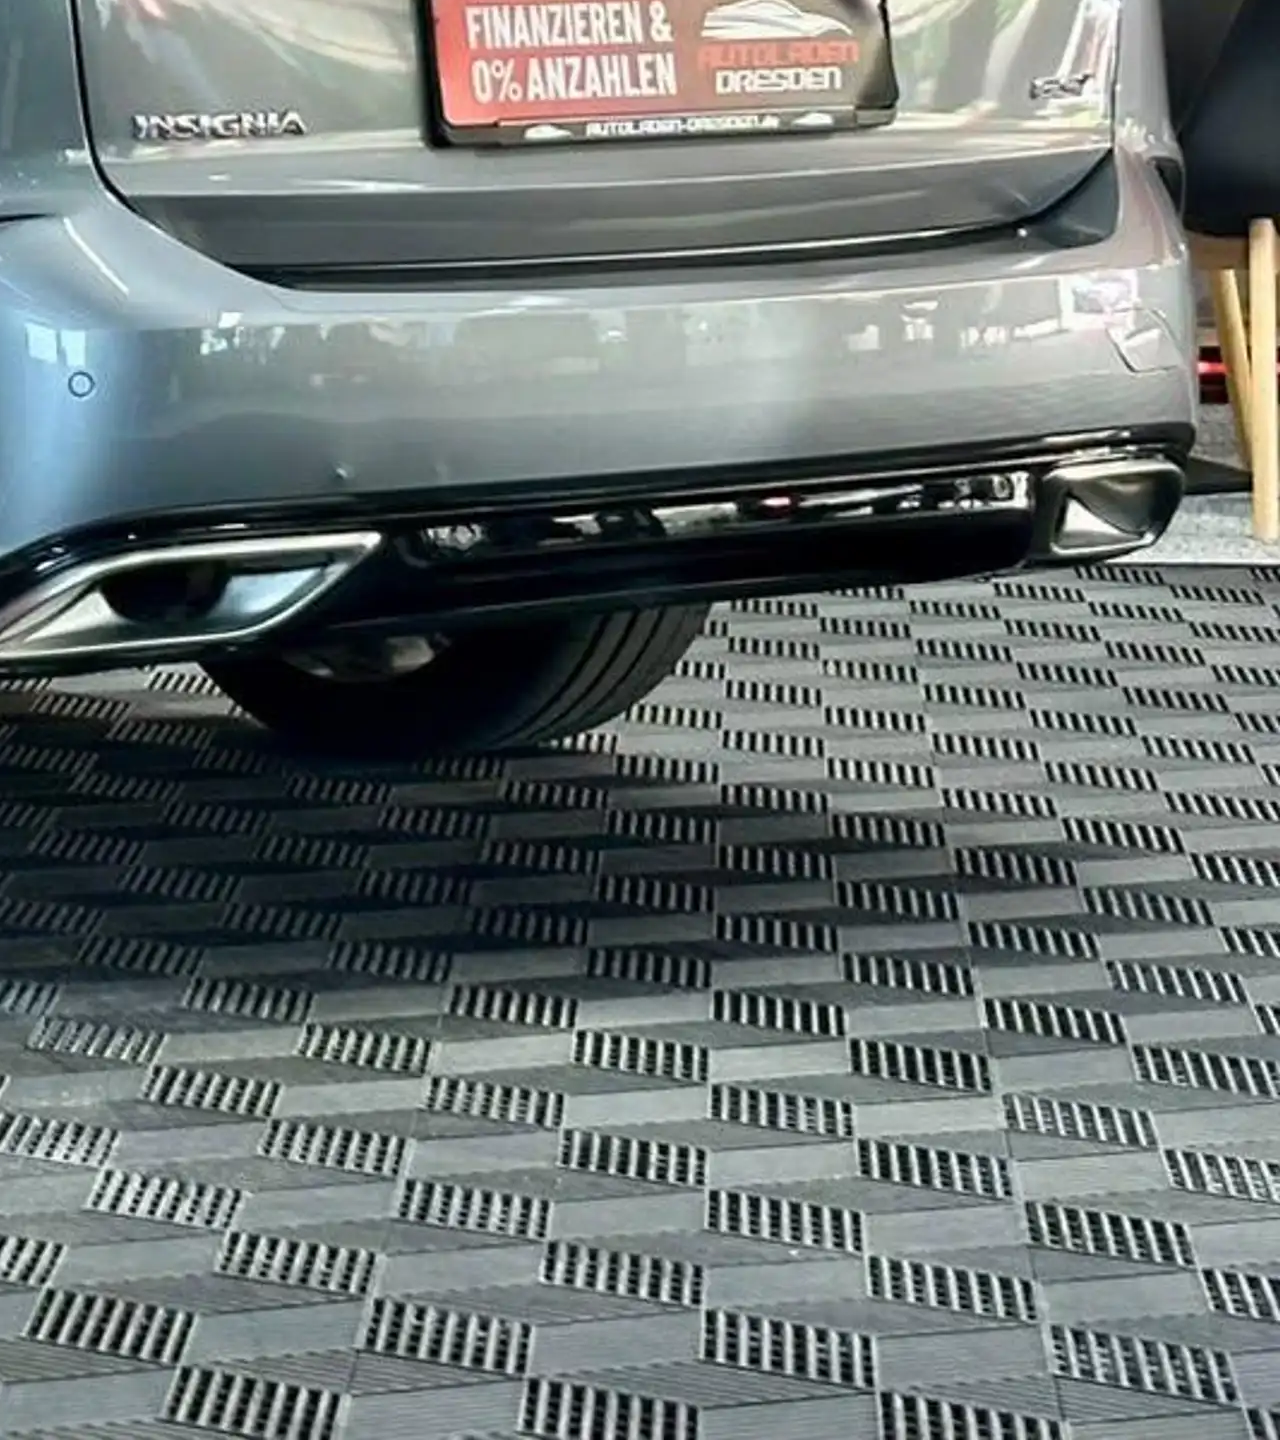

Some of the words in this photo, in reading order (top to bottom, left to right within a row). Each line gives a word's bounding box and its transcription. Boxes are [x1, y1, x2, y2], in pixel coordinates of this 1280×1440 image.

[465, 0, 643, 50] FINANZIEREN
[648, 0, 674, 42] &
[698, 40, 860, 72] AUTOLADEN
[471, 58, 522, 104] 0%
[527, 52, 678, 101] ANZAHLEN
[715, 66, 843, 95] DRESDEN
[132, 111, 308, 140] INSIGNIA
